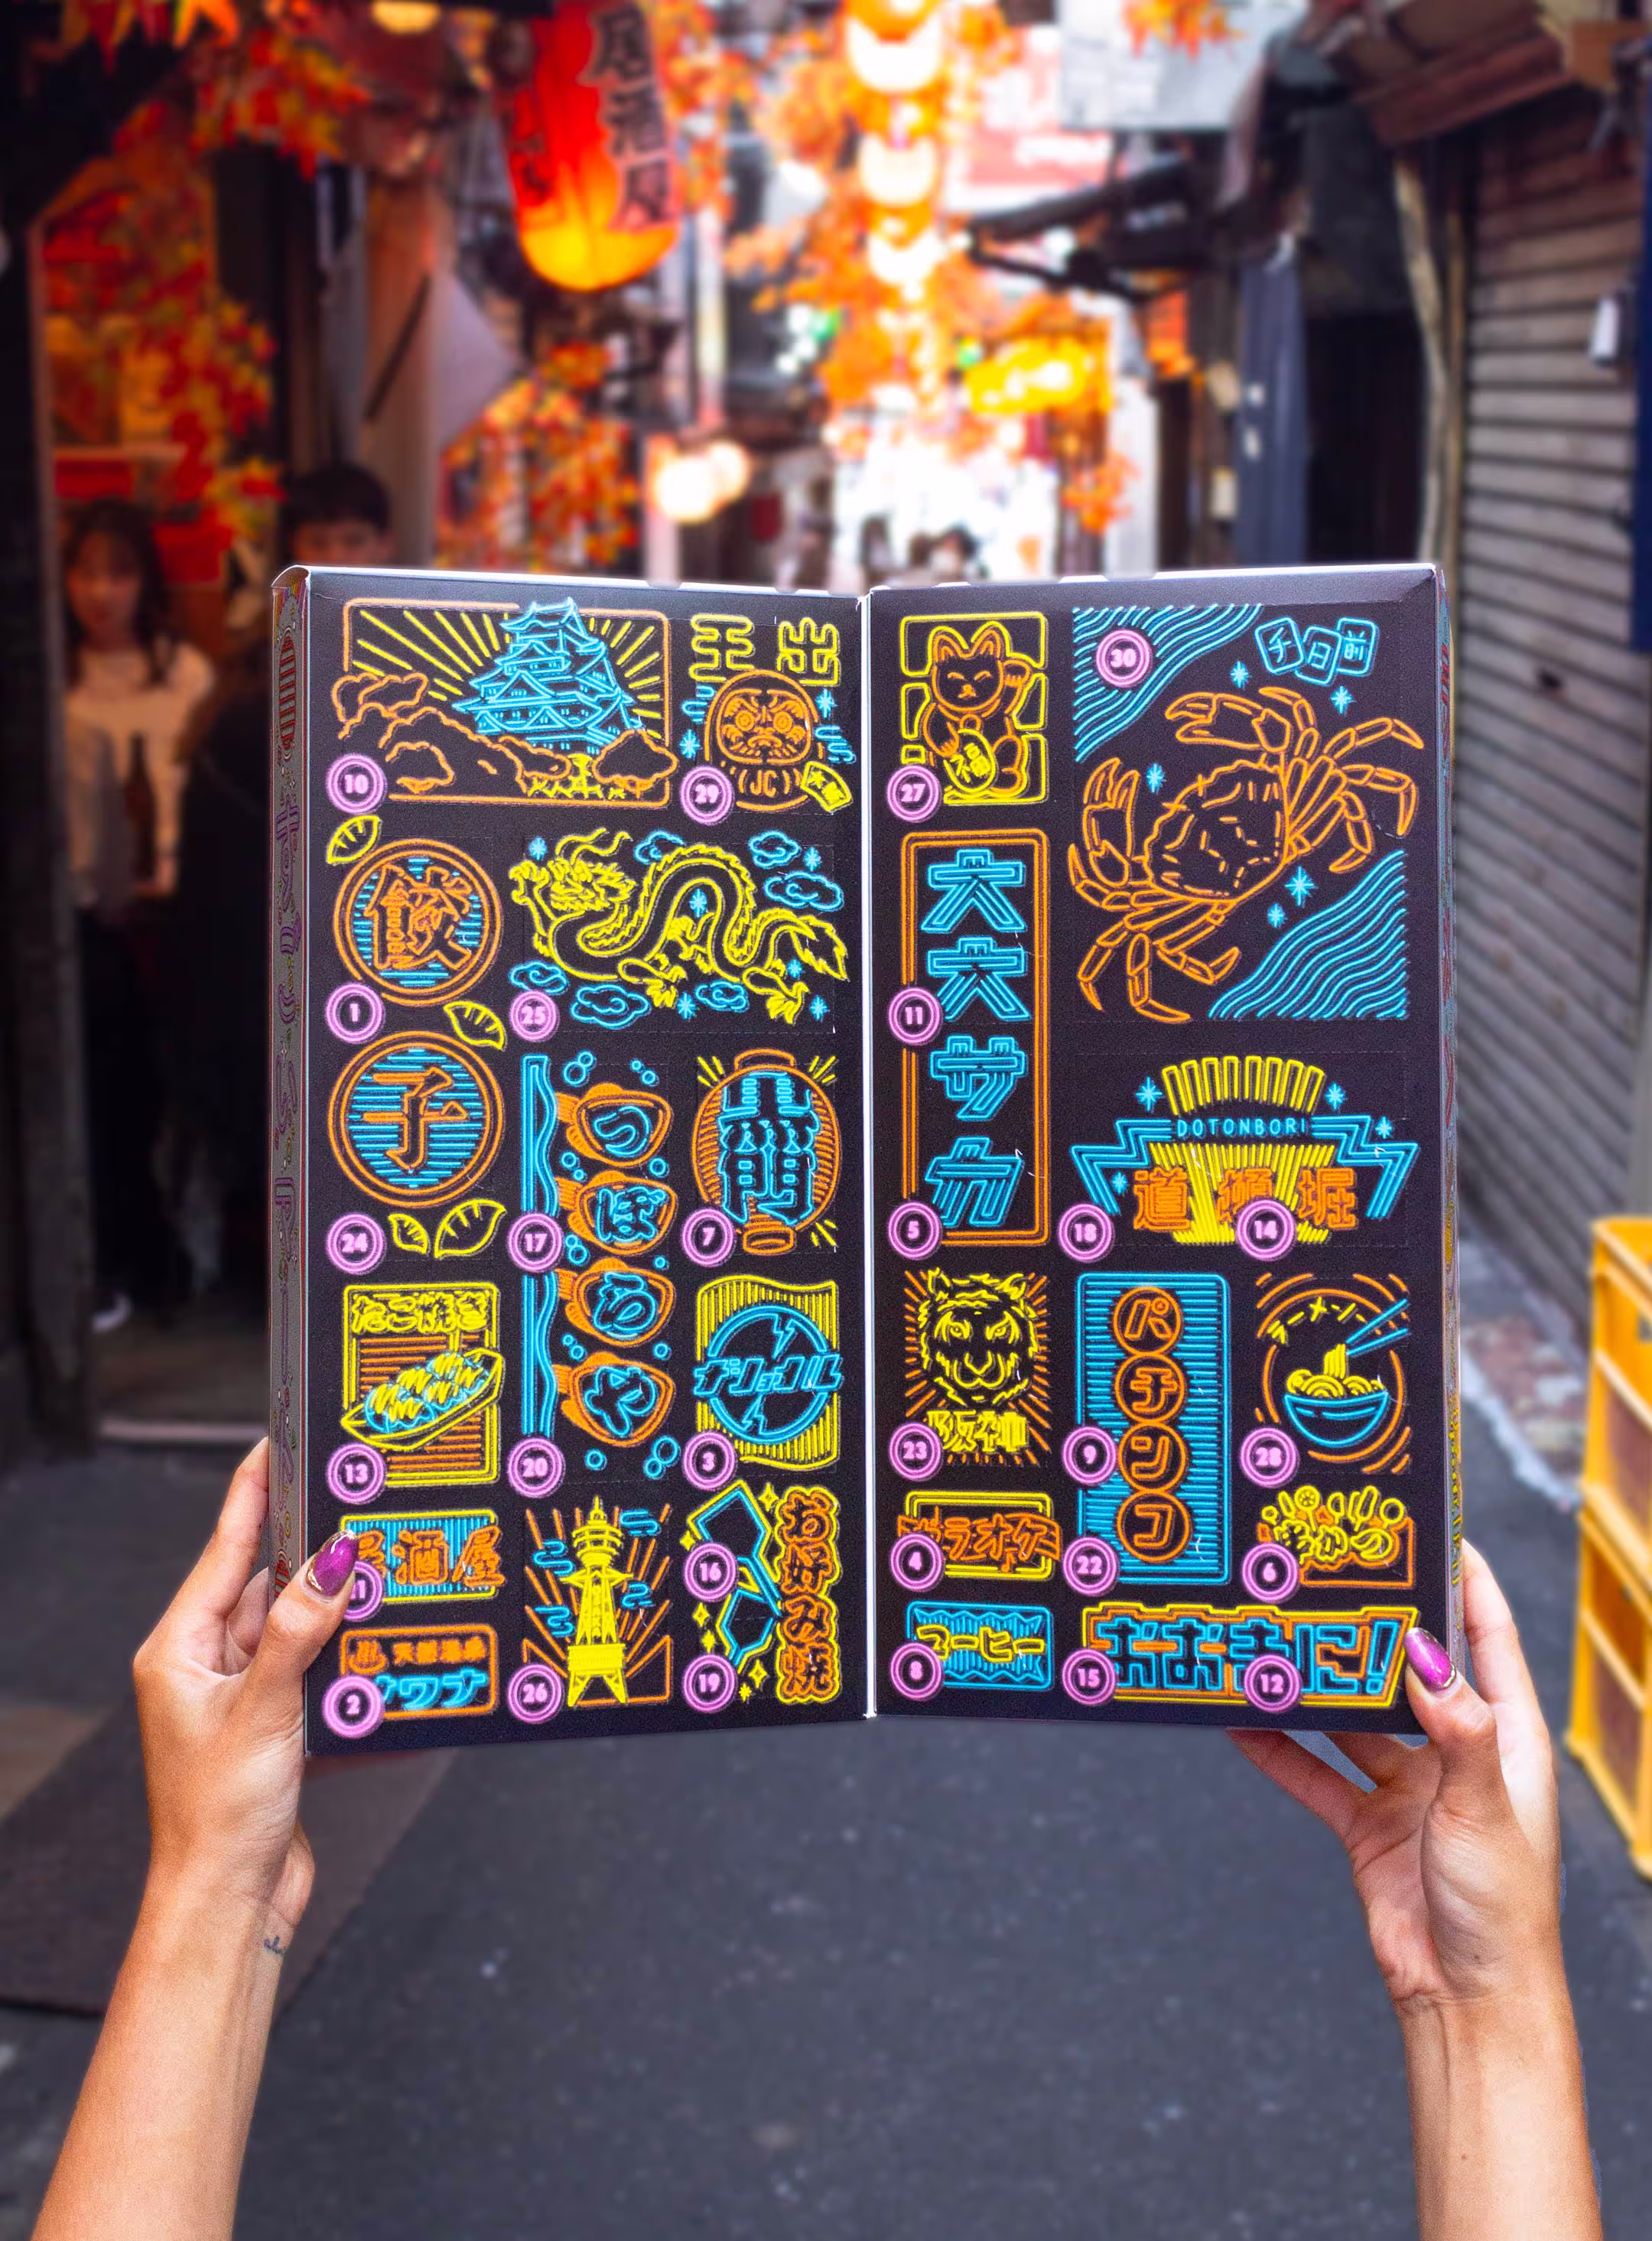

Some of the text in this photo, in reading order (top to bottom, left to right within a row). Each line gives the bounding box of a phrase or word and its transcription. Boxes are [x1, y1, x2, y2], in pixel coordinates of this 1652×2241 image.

[1110, 648, 1137, 668] 30
[1265, 624, 1367, 673] 千日前
[344, 774, 369, 795] 10
[694, 783, 720, 804] 29
[901, 783, 926, 802] 27
[350, 1003, 359, 1023] 1
[522, 1006, 546, 1024] 25
[905, 1007, 923, 1025] 11
[1176, 1117, 1306, 1138] DOTONBORI
[702, 1227, 716, 1247] 7
[906, 1221, 920, 1240] 5
[1074, 1222, 1098, 1242] 18
[1254, 1220, 1279, 1240] 14
[342, 1233, 368, 1253] 24
[524, 1233, 548, 1253] 17
[1124, 1297, 1179, 1547] パチンコ
[903, 1441, 928, 1460] 23
[1083, 1445, 1097, 1465] 9
[1255, 1446, 1282, 1467] 28
[522, 1457, 548, 1478] 20
[701, 1452, 715, 1472] 3
[344, 1463, 369, 1484] 13
[909, 1551, 922, 1571] 4
[1076, 1555, 1102, 1575] 22
[699, 1562, 722, 1582] 16
[1263, 1562, 1276, 1583] 6
[916, 1625, 1046, 1663] コーヒー
[910, 1660, 923, 1680] 8
[1077, 1668, 1101, 1688] 15
[522, 1683, 548, 1703] 26
[699, 1673, 721, 1693] 19
[1260, 1673, 1284, 1693] 12
[346, 1694, 360, 1715] 2
